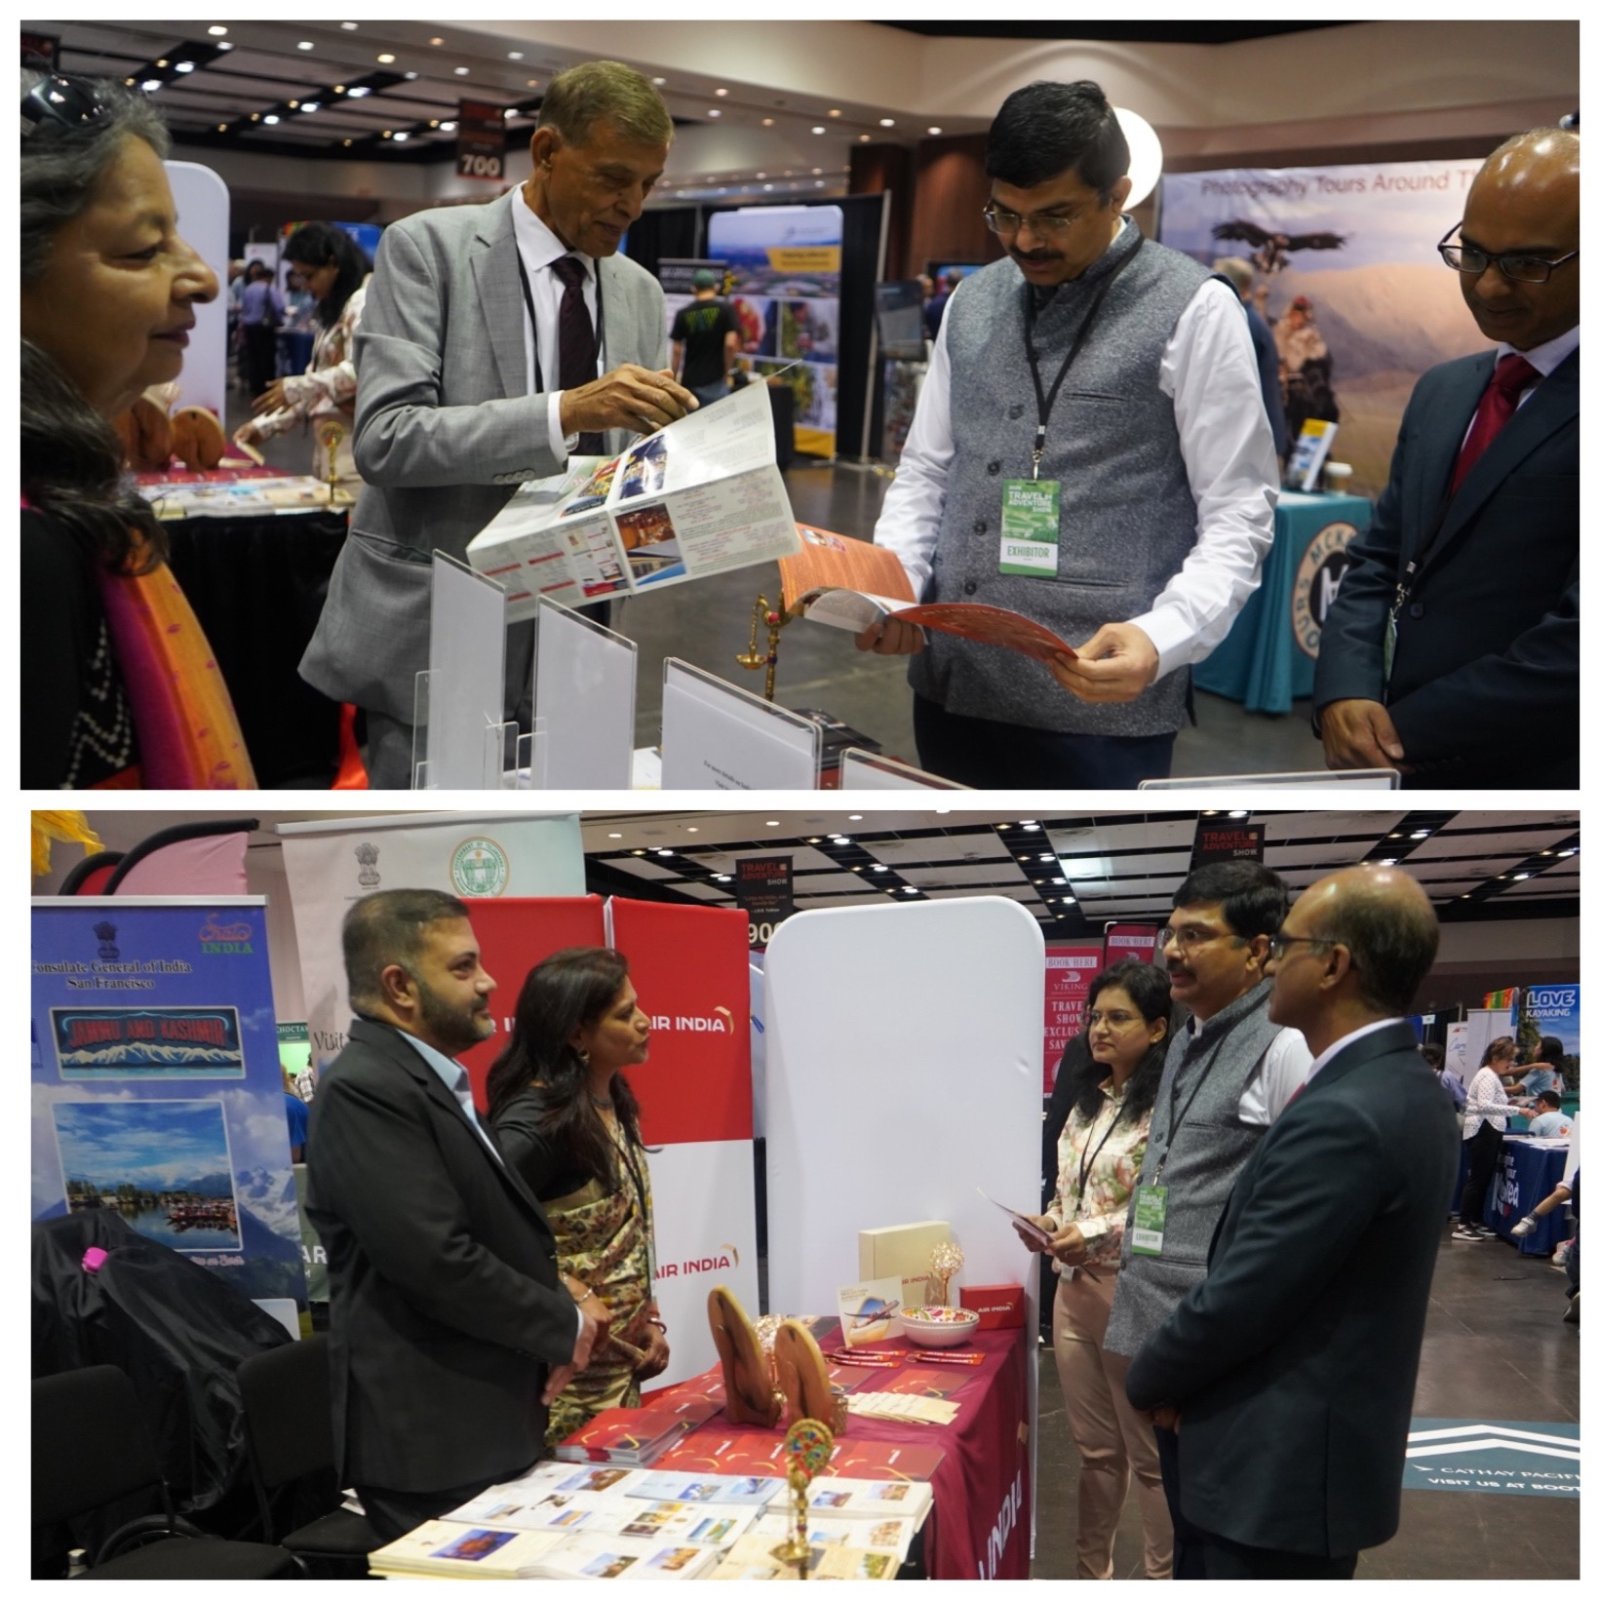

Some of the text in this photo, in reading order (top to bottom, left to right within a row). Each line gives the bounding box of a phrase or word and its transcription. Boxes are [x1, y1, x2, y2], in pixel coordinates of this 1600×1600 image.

[462, 154, 501, 177] 700
[1201, 177, 1308, 199] Photography
[1315, 175, 1366, 194] Tours
[1372, 171, 1450, 193] Around
[1008, 491, 1043, 500] TRAVEL
[1007, 545, 1050, 559] EXHIBITOR
[1202, 831, 1245, 841] TRAVEL
[1233, 848, 1258, 857] SHOW
[742, 862, 779, 873] TRAVEL
[767, 878, 788, 886] SHOW
[749, 922, 782, 944] 90
[1110, 936, 1154, 946] BOOK HERE
[201, 942, 253, 955] INDIA
[91, 959, 142, 974] General
[142, 959, 156, 972] of
[157, 958, 193, 973] India
[1047, 957, 1096, 968] BOOK HERE
[66, 976, 156, 990] San Francisco
[1053, 983, 1089, 991] VIKING
[1526, 990, 1576, 1008] LOVE
[1052, 1001, 1083, 1012] TRAVE
[1526, 1008, 1571, 1018] KAYAKING
[650, 1016, 726, 1032] IR INDIA
[69, 1018, 227, 1048] JAMMU AND KASHMIR
[1045, 1027, 1080, 1037] EXCLUS
[313, 1031, 345, 1051] Visit
[1048, 1039, 1069, 1050] SAV
[301, 1245, 328, 1264] AR
[683, 1256, 730, 1275] INDIA
[1440, 1466, 1516, 1477] CATHAY
[1427, 1477, 1472, 1486] VISIT
[1475, 1480, 1500, 1488] US
[1530, 1484, 1580, 1492] BOOT
